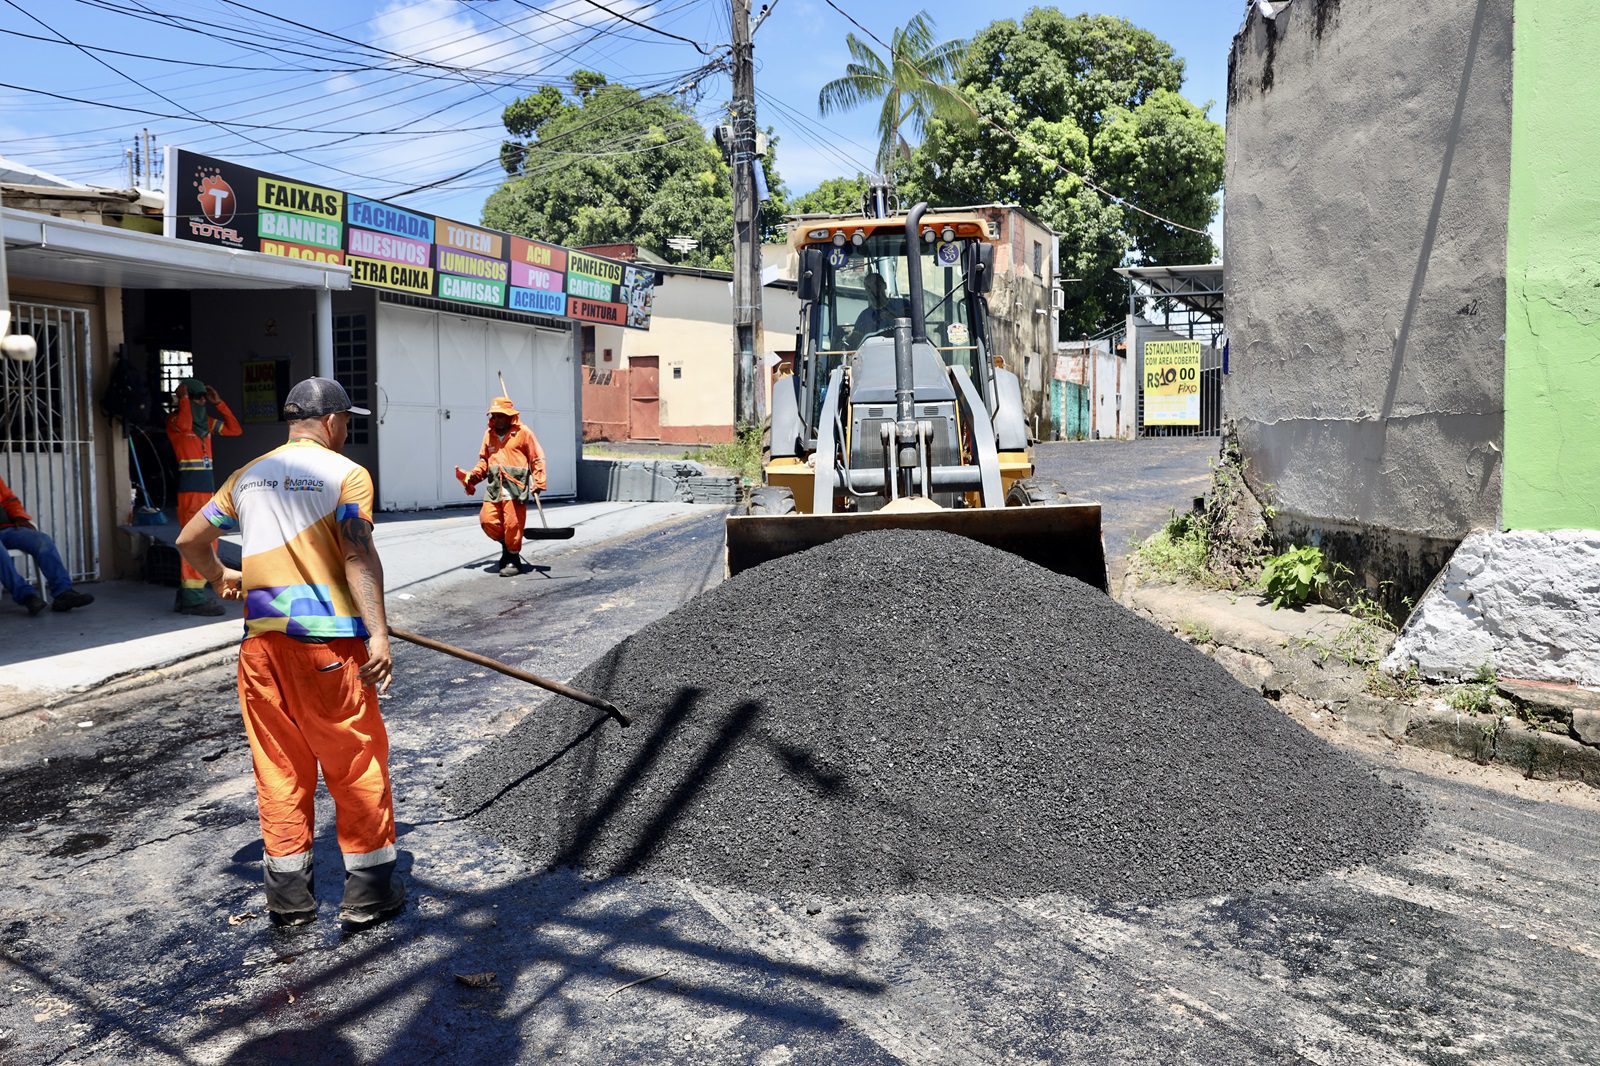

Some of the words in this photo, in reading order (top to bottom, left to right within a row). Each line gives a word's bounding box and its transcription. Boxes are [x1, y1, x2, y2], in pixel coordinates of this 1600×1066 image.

[265, 183, 338, 216] FAIXAS
[189, 222, 244, 242] TOTAL
[262, 212, 339, 250] BANNER
[352, 202, 430, 240] FACHADA
[351, 233, 426, 266] ADESIVOS
[447, 226, 492, 253] TOTEM
[440, 250, 507, 281] LUMINOSOS
[526, 245, 551, 266] ACM
[390, 266, 429, 290] CAIXA
[528, 269, 550, 289] PVC
[571, 255, 620, 281] PANFLETOS
[443, 277, 500, 304] CAMISAS
[514, 290, 561, 312] ACRÍLICO
[569, 277, 612, 301] CARTÕES
[572, 301, 578, 314] E
[581, 303, 618, 321] PINTURA
[1145, 342, 1200, 355] ESTACIONAMENTO
[1145, 357, 1157, 366] COM
[1174, 356, 1199, 365] COBERTA
[289, 478, 324, 488] Manaus
